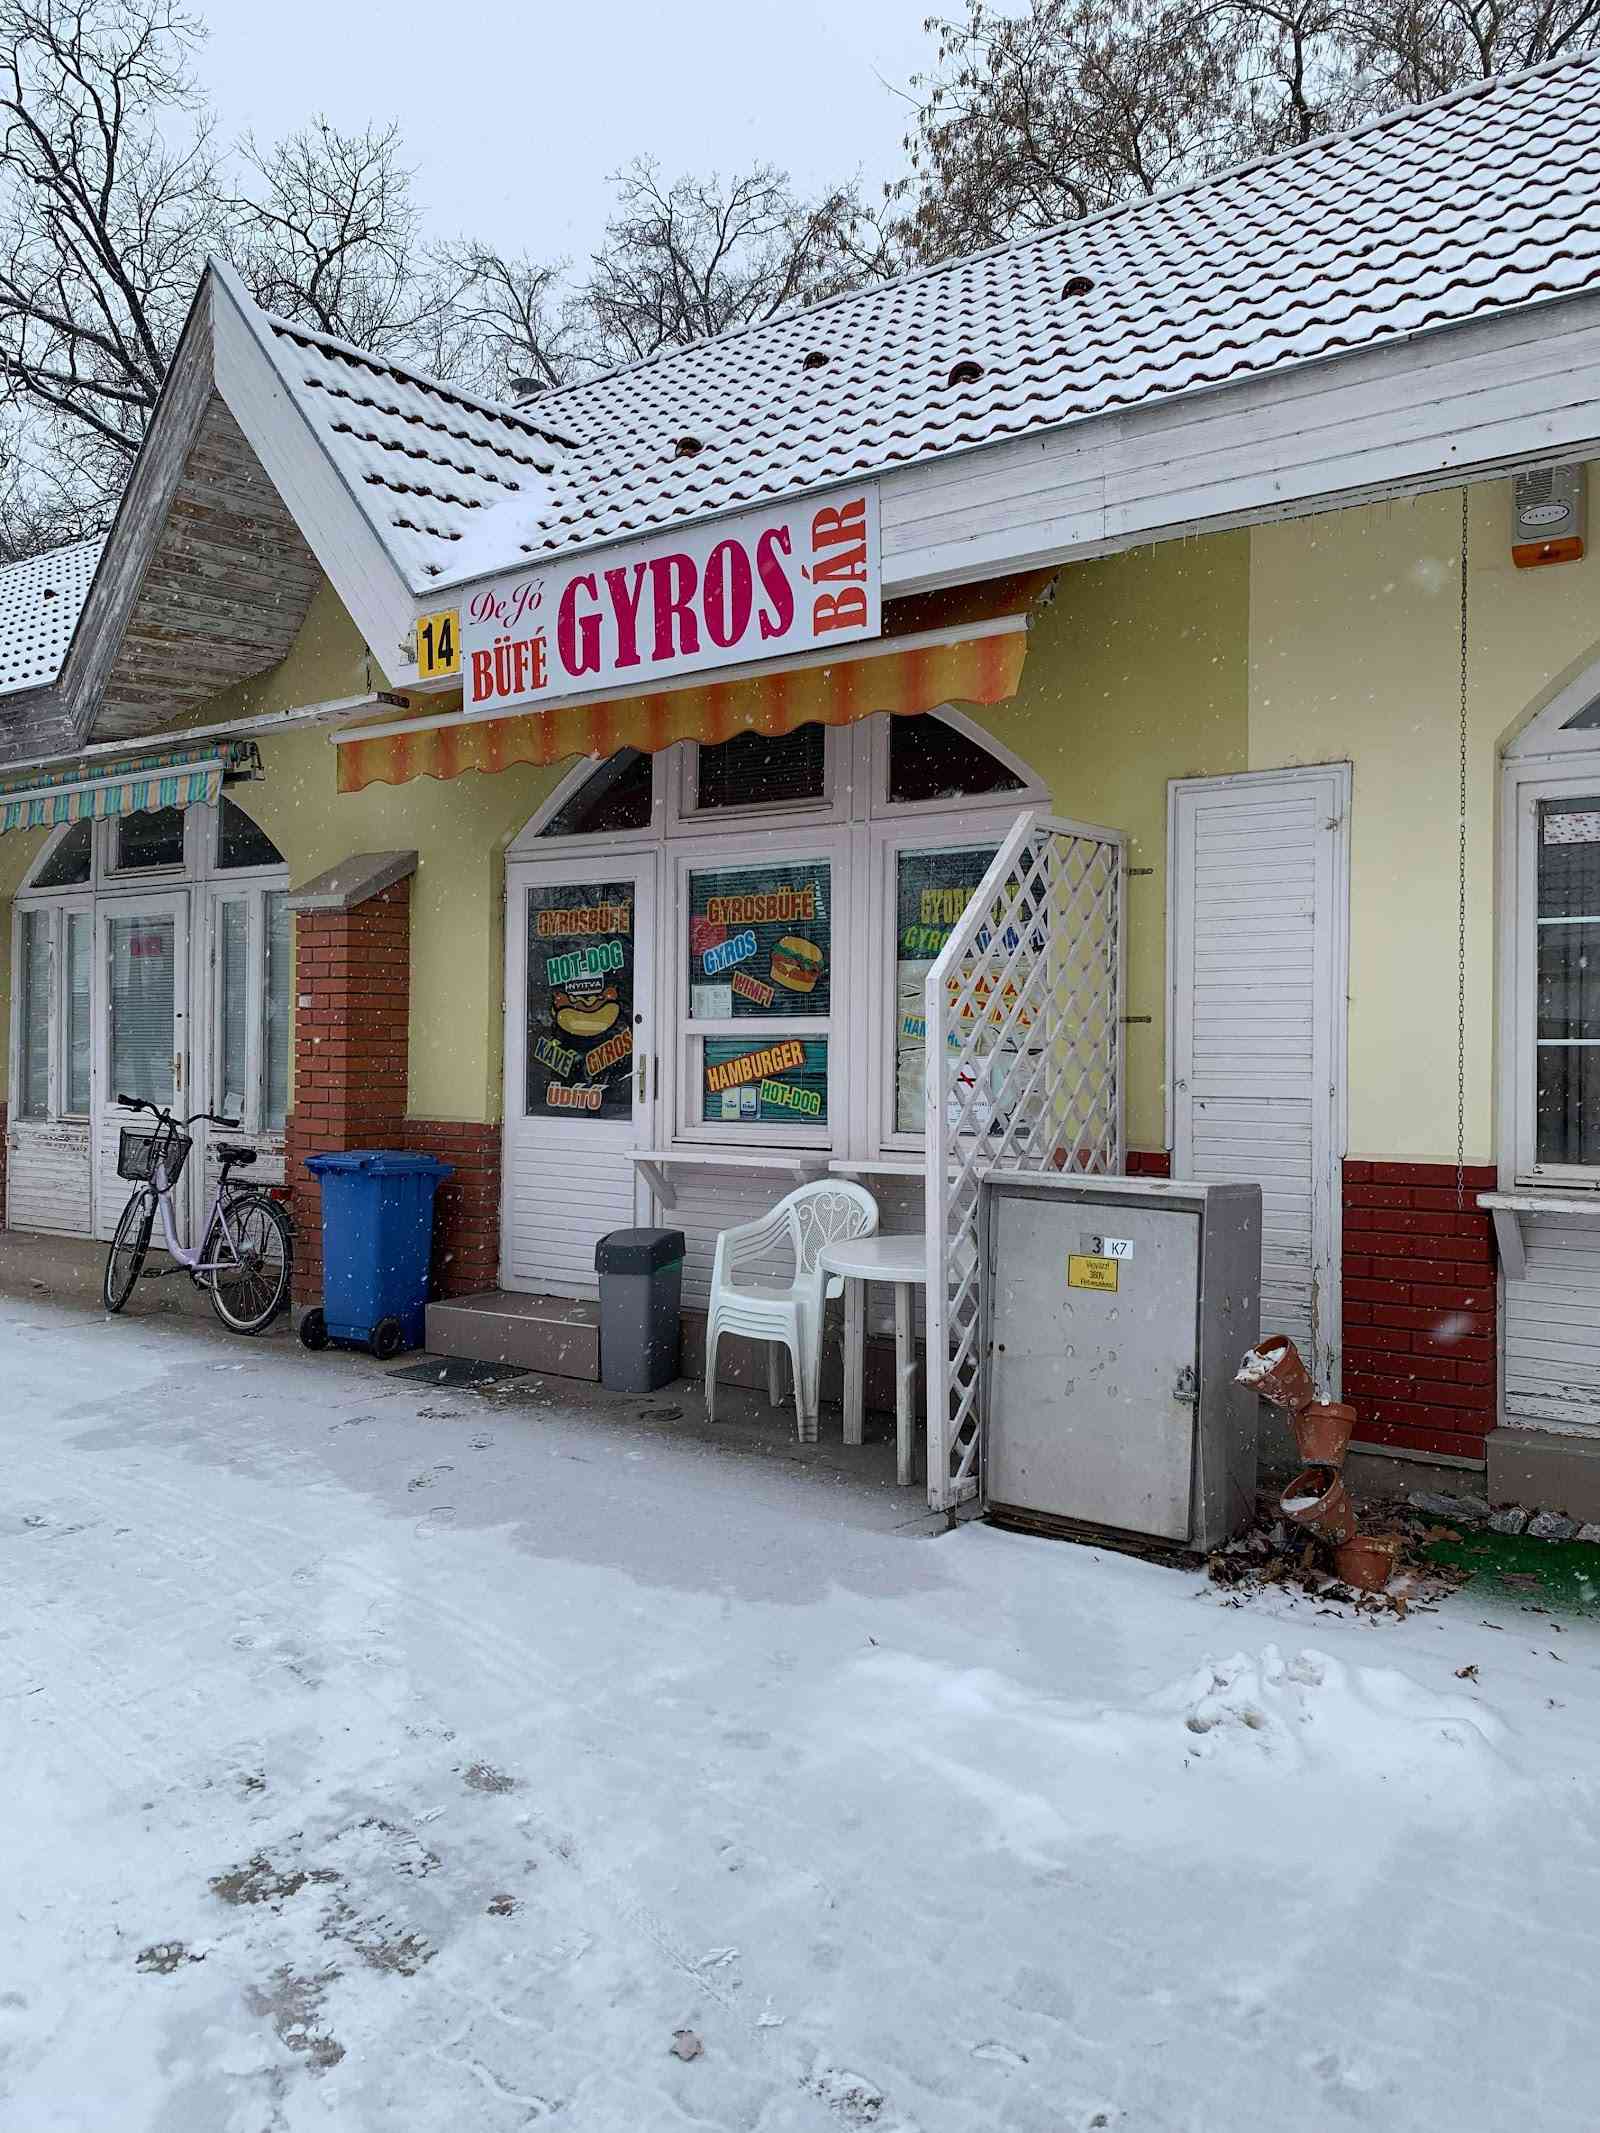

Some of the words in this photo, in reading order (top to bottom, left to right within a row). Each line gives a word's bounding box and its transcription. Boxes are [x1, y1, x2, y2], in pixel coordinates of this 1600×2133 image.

[802, 497, 867, 637] BÁR
[557, 525, 795, 677] GYROS
[421, 619, 454, 671] 14
[471, 627, 548, 703] BÜFÉ
[707, 884, 815, 925] GYROSBÜFÉ
[547, 941, 624, 986] HOT-DOG
[703, 930, 757, 974] GYROS
[535, 1036, 575, 1077] KÁVÉ
[586, 1030, 632, 1076] GYROS
[707, 1041, 804, 1091] HAMBURGER
[761, 1080, 820, 1114] HOT-DOG
[1092, 1236, 1101, 1254] 3
[1111, 1242, 1127, 1256] K7
